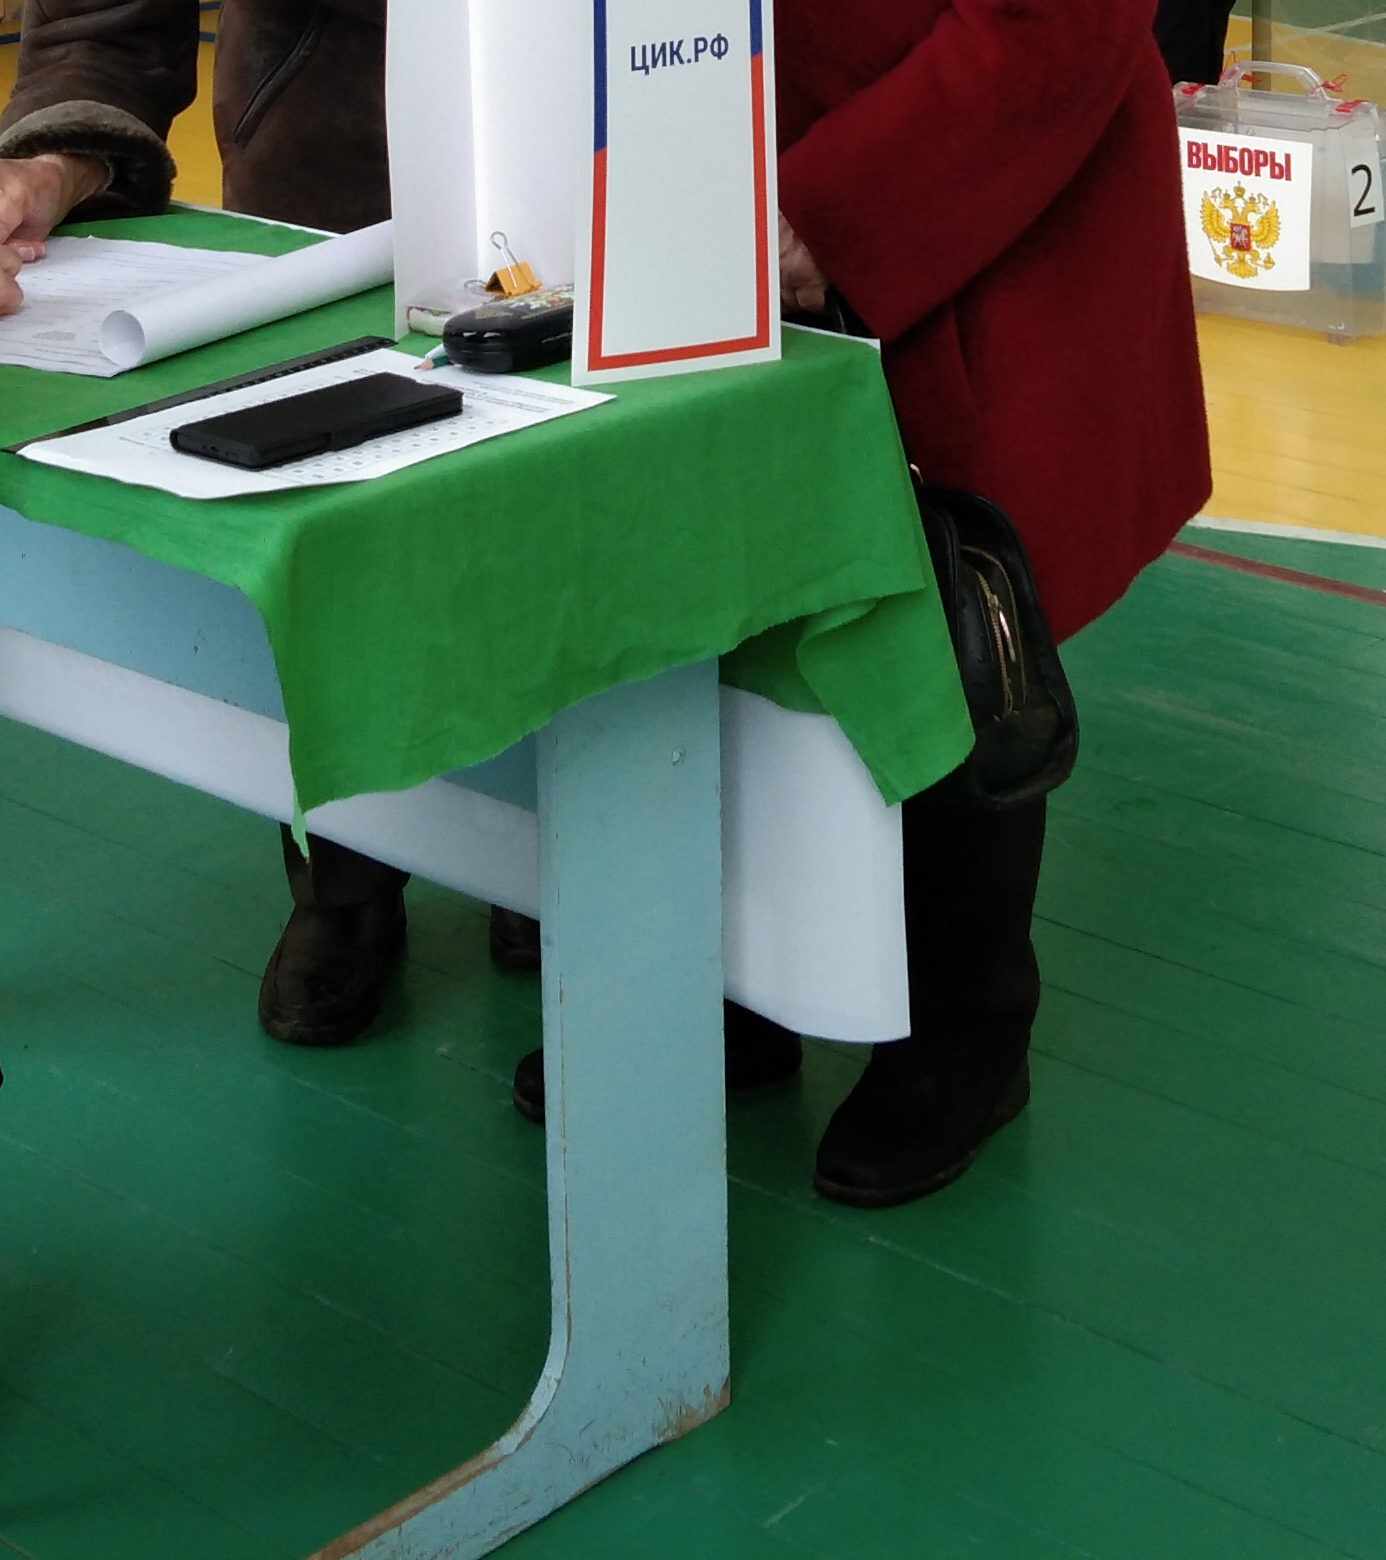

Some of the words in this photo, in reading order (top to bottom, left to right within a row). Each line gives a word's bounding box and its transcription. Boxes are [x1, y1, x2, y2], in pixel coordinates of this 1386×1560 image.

[630, 33, 730, 76] ЦИК.РФ
[1186, 140, 1292, 182] ВЫБОРЫ
[1350, 163, 1376, 218] 2
